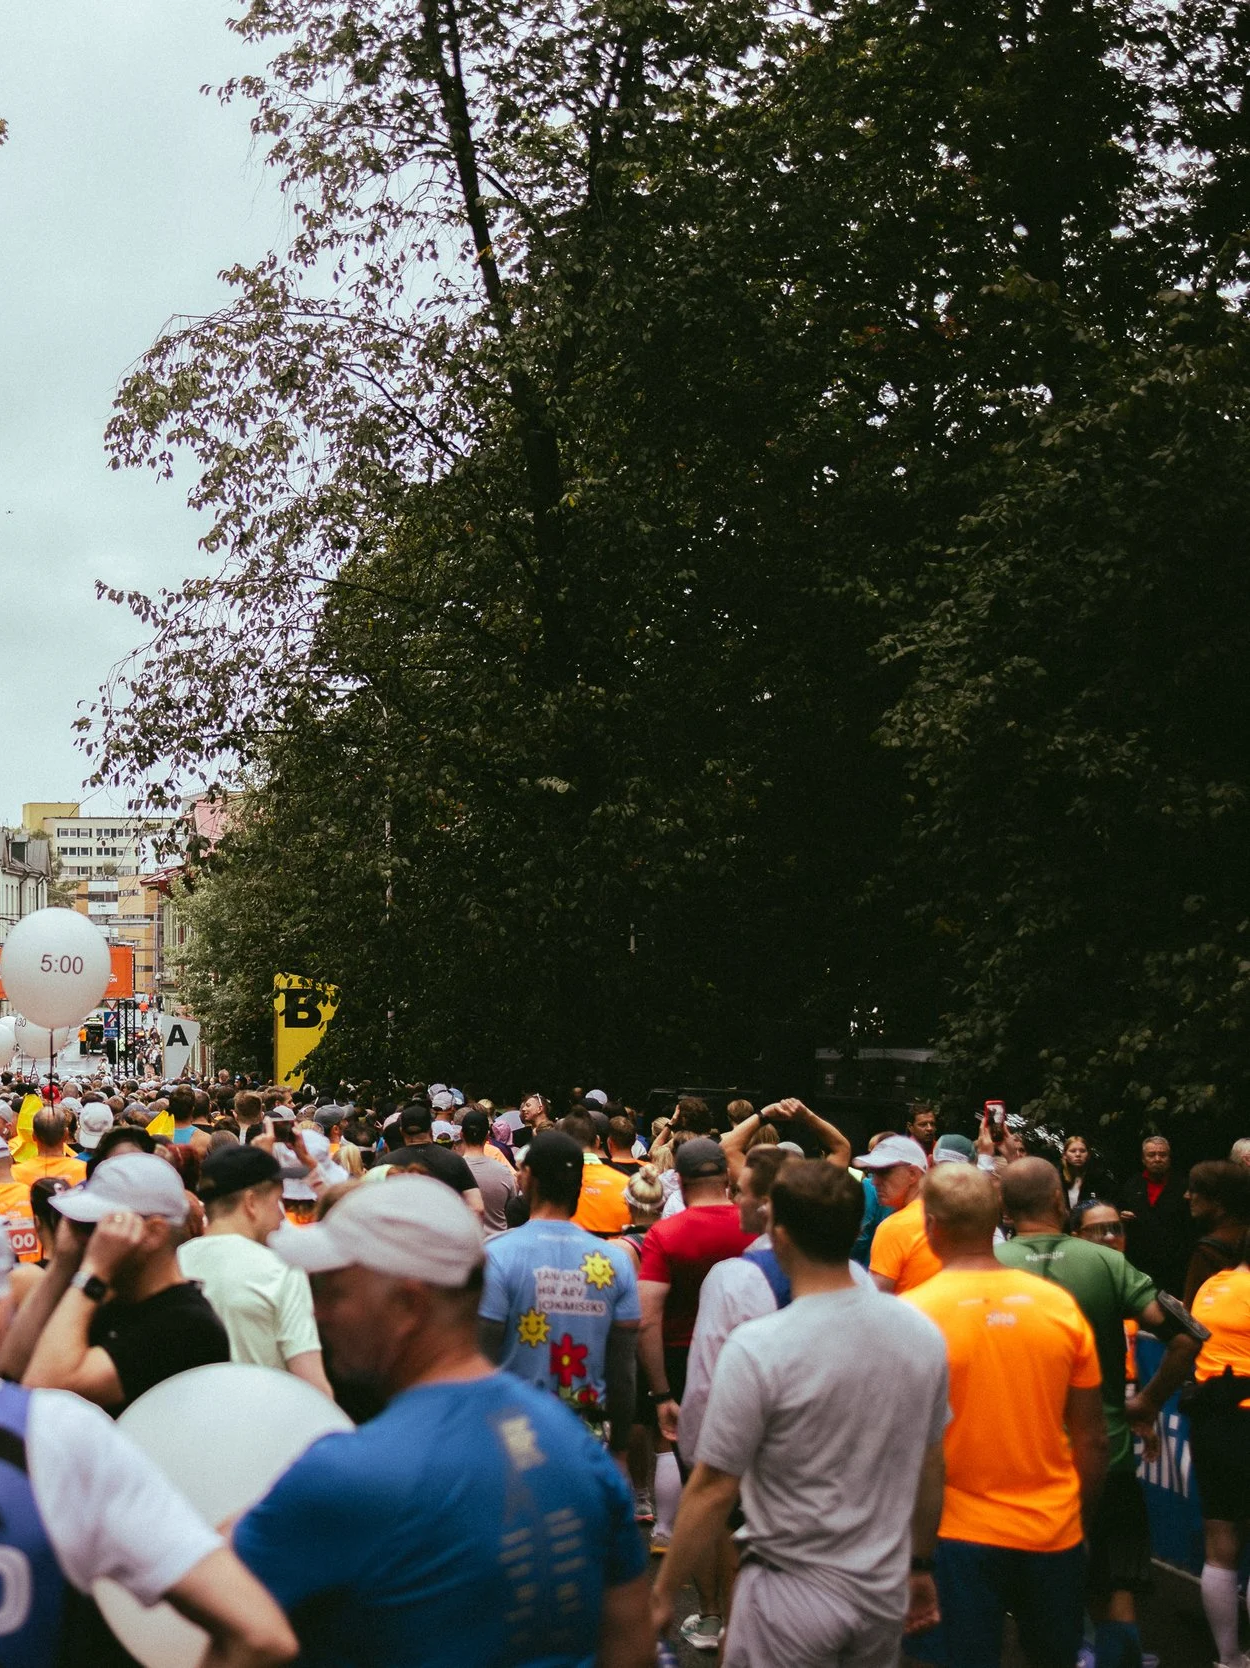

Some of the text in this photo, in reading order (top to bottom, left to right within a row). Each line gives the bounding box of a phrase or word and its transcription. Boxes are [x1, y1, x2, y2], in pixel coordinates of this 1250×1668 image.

[40, 954, 84, 975] 5:00
[284, 988, 322, 1028] B
[166, 1024, 189, 1046] A
